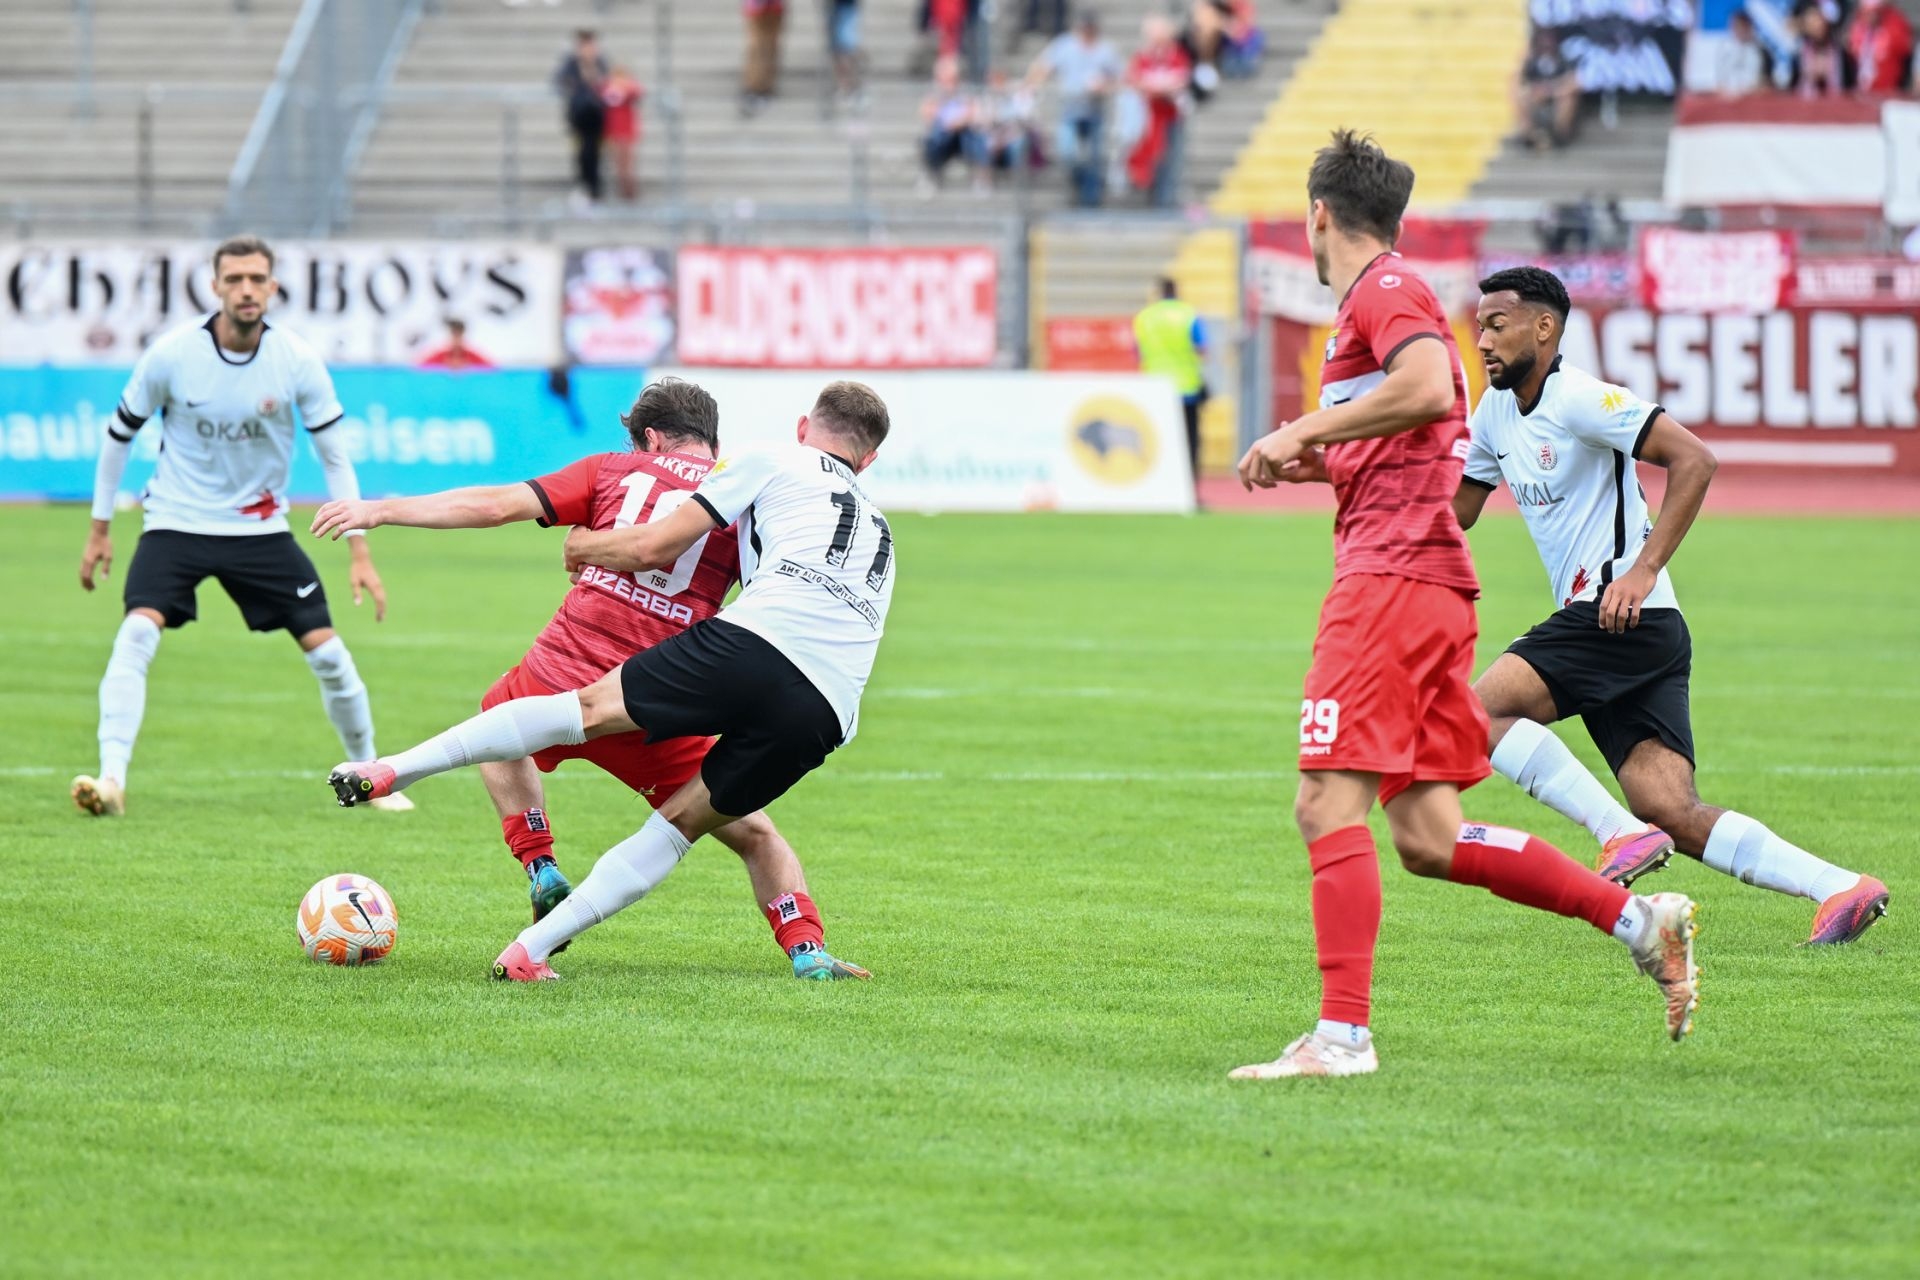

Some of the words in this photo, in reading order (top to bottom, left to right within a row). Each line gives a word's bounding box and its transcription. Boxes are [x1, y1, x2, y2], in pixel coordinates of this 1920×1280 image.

[196, 418, 269, 442] OKAL
[652, 455, 709, 483] AKKAY
[824, 490, 894, 594] 11
[580, 565, 694, 626] BIZERBA
[651, 574, 668, 589] TSG
[1299, 698, 1340, 745] 29
